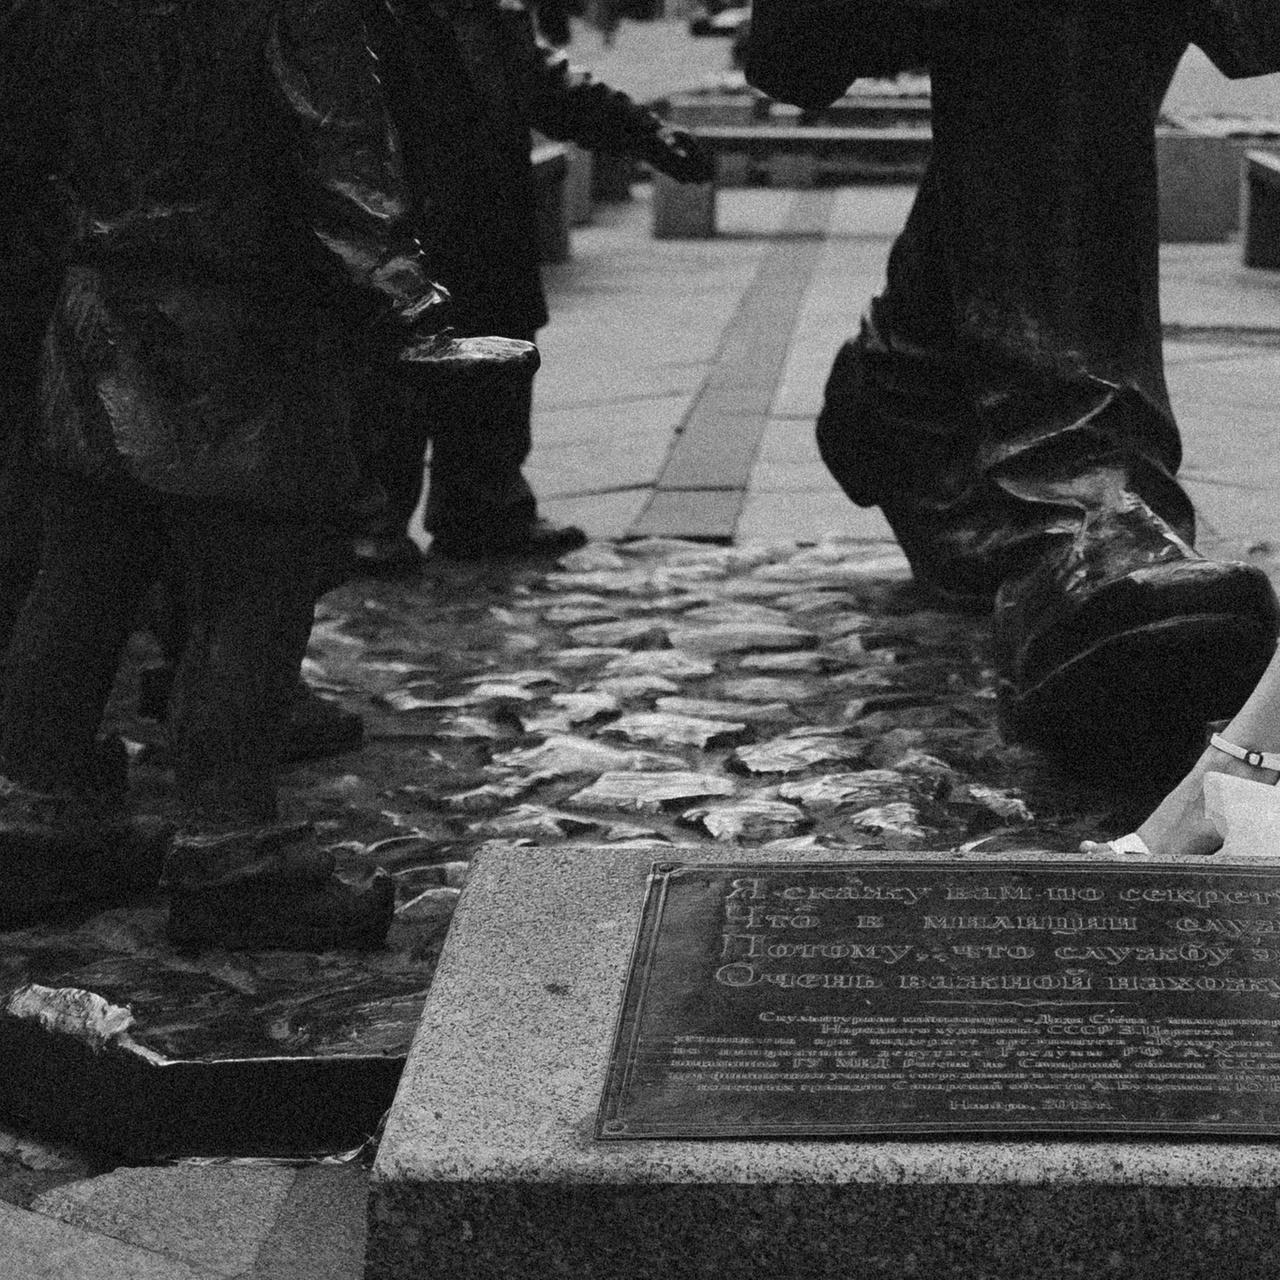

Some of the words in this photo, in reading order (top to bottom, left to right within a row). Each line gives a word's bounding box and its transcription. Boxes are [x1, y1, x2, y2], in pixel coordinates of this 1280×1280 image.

[726, 879, 766, 900] Я
[783, 887, 932, 904] скажу
[946, 887, 1033, 900] вам
[1048, 888, 1104, 901] по
[726, 905, 820, 929] Что
[856, 915, 884, 929] в
[923, 916, 1137, 935] милиции
[951, 945, 1034, 960] что
[1055, 943, 1235, 967] службу
[716, 962, 884, 989] Очень
[900, 968, 1091, 990] важной
[1047, 1025, 1113, 1035] СССР
[1122, 1046, 1163, 1057] РФ
[792, 1058, 823, 1069] ГУ
[836, 1058, 891, 1070] МВД
